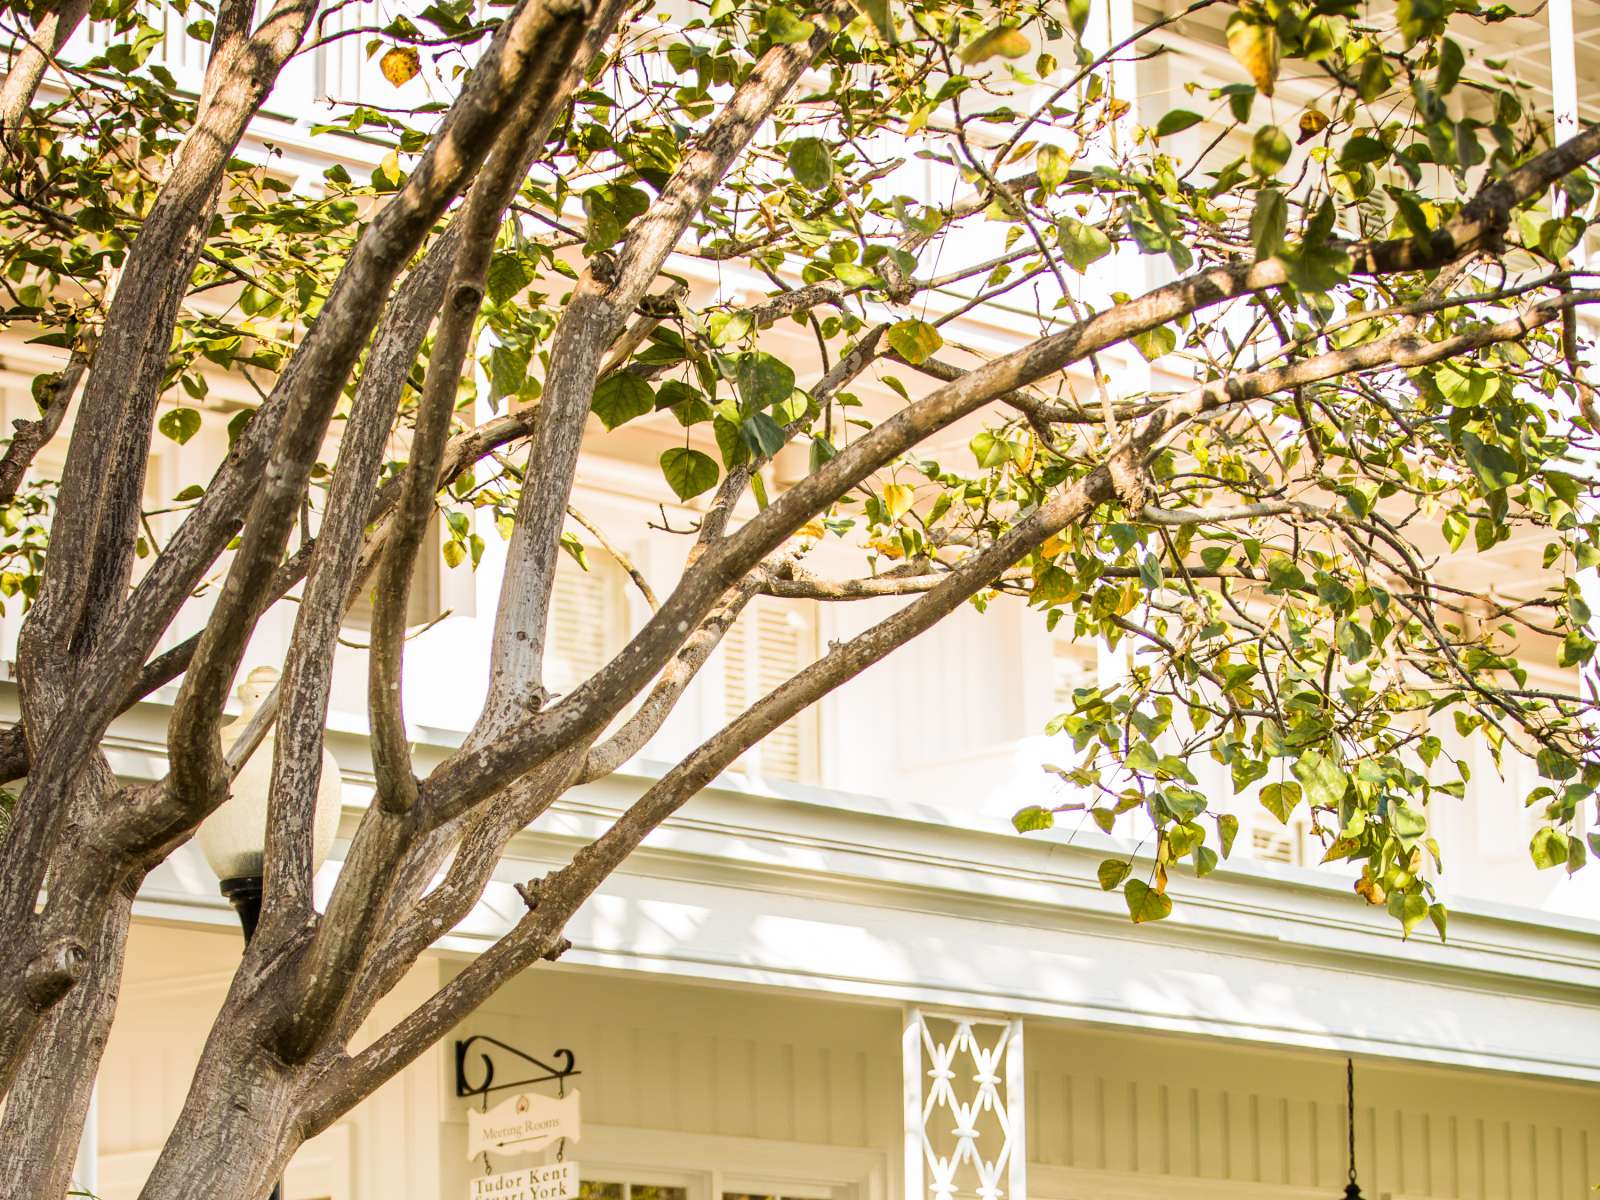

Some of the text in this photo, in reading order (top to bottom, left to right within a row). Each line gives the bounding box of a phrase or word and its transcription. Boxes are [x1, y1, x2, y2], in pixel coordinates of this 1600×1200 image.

[483, 1119, 560, 1140] Meeting Rooms
[476, 1167, 567, 1194] Tudor Kent
[530, 1181, 567, 1200] York
